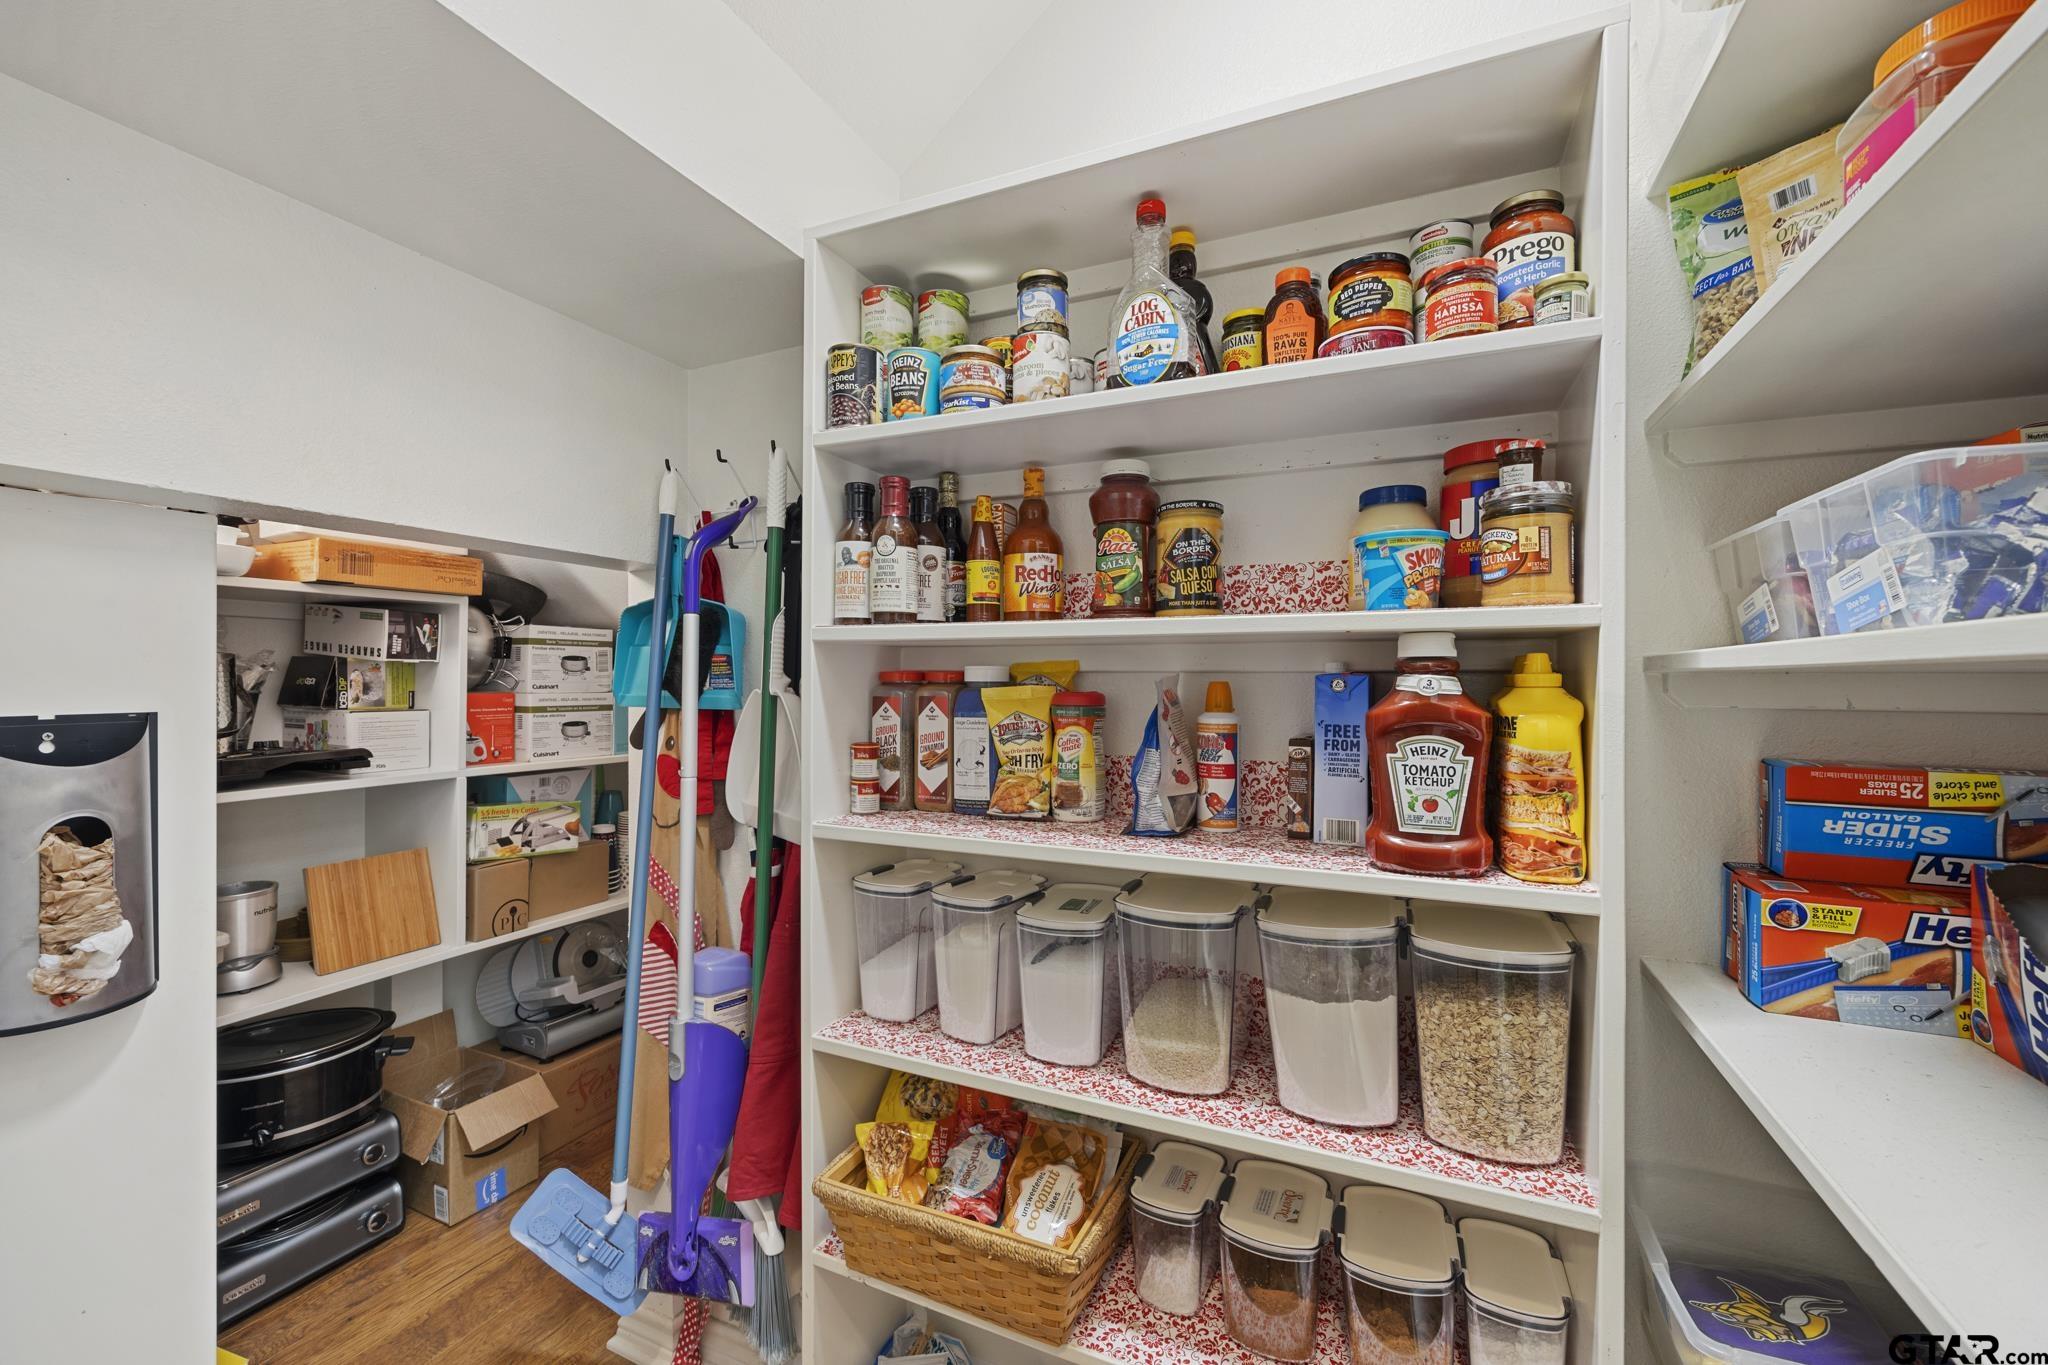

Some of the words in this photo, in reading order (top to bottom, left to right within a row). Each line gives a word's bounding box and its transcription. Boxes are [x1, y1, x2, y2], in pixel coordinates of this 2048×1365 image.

[1492, 235, 1565, 264] Prego
[1497, 263, 1534, 285] Roasted
[1535, 260, 1561, 271] Garlic
[1731, 259, 1755, 276] BAK
[1514, 277, 1522, 286] &
[1523, 270, 1547, 283] Herb
[1340, 288, 1353, 300] RED
[1354, 282, 1383, 292] PEPPER
[1441, 292, 1475, 303] TRADITIONAL
[1131, 298, 1158, 317] LOG
[1434, 302, 1484, 320] HARISSA
[1125, 310, 1166, 333] CABIN
[1273, 333, 1290, 341] 100%
[1273, 340, 1295, 351] RAW
[1298, 338, 1307, 347] &
[1274, 348, 1307, 357] UNFILTERED
[893, 356, 921, 369] HEINZ
[1122, 362, 1146, 374] Sugar
[1147, 358, 1170, 367] Free
[835, 382, 859, 390] Beans
[890, 372, 925, 387] BEANS
[1097, 539, 1138, 556] Pace
[1172, 545, 1213, 556] BORDER
[1175, 541, 1190, 549] ON
[1191, 539, 1206, 548] THE
[1101, 558, 1132, 571] SALSA
[1405, 546, 1441, 571] SKIPP
[1481, 551, 1521, 568] ATURAL
[1170, 567, 1199, 584] SALSA
[1201, 565, 1218, 579] CON
[1180, 579, 1213, 596] QUESO
[337, 644, 382, 658] SHARPER
[1426, 679, 1433, 687] 3
[875, 723, 898, 736] GROUND
[996, 720, 1041, 737] LOUISIANA
[1323, 724, 1361, 739] FREE
[919, 731, 945, 744] GROUND
[1057, 737, 1081, 748] Coffee
[919, 742, 945, 754] CINNAMON
[1061, 744, 1081, 753] mate
[1323, 739, 1361, 752] FROM
[1410, 745, 1449, 758] HEINZ
[880, 746, 897, 759] EPPER
[1025, 753, 1045, 768] FRY
[1057, 761, 1078, 770] ZERO
[1327, 767, 1360, 775] ARTIFICIAL
[1401, 764, 1457, 778] TOMATO
[1404, 775, 1454, 787] KETCHUP
[1867, 780, 1898, 789] BAGS
[1935, 780, 1966, 791] store
[1971, 780, 1997, 791] and
[1859, 787, 1897, 798] SLIDER
[1900, 781, 1924, 800] 25
[1933, 790, 1969, 802] circle
[1974, 790, 2001, 802] Just
[1842, 810, 1923, 824] GALLON
[1822, 818, 1952, 846] SLIDER
[1844, 836, 1915, 850] FREEZER
[1811, 906, 1854, 917] STAND
[1821, 914, 1846, 923] FILL
[1026, 1169, 1061, 1232] coconut
[1045, 1191, 1061, 1213] flakes
